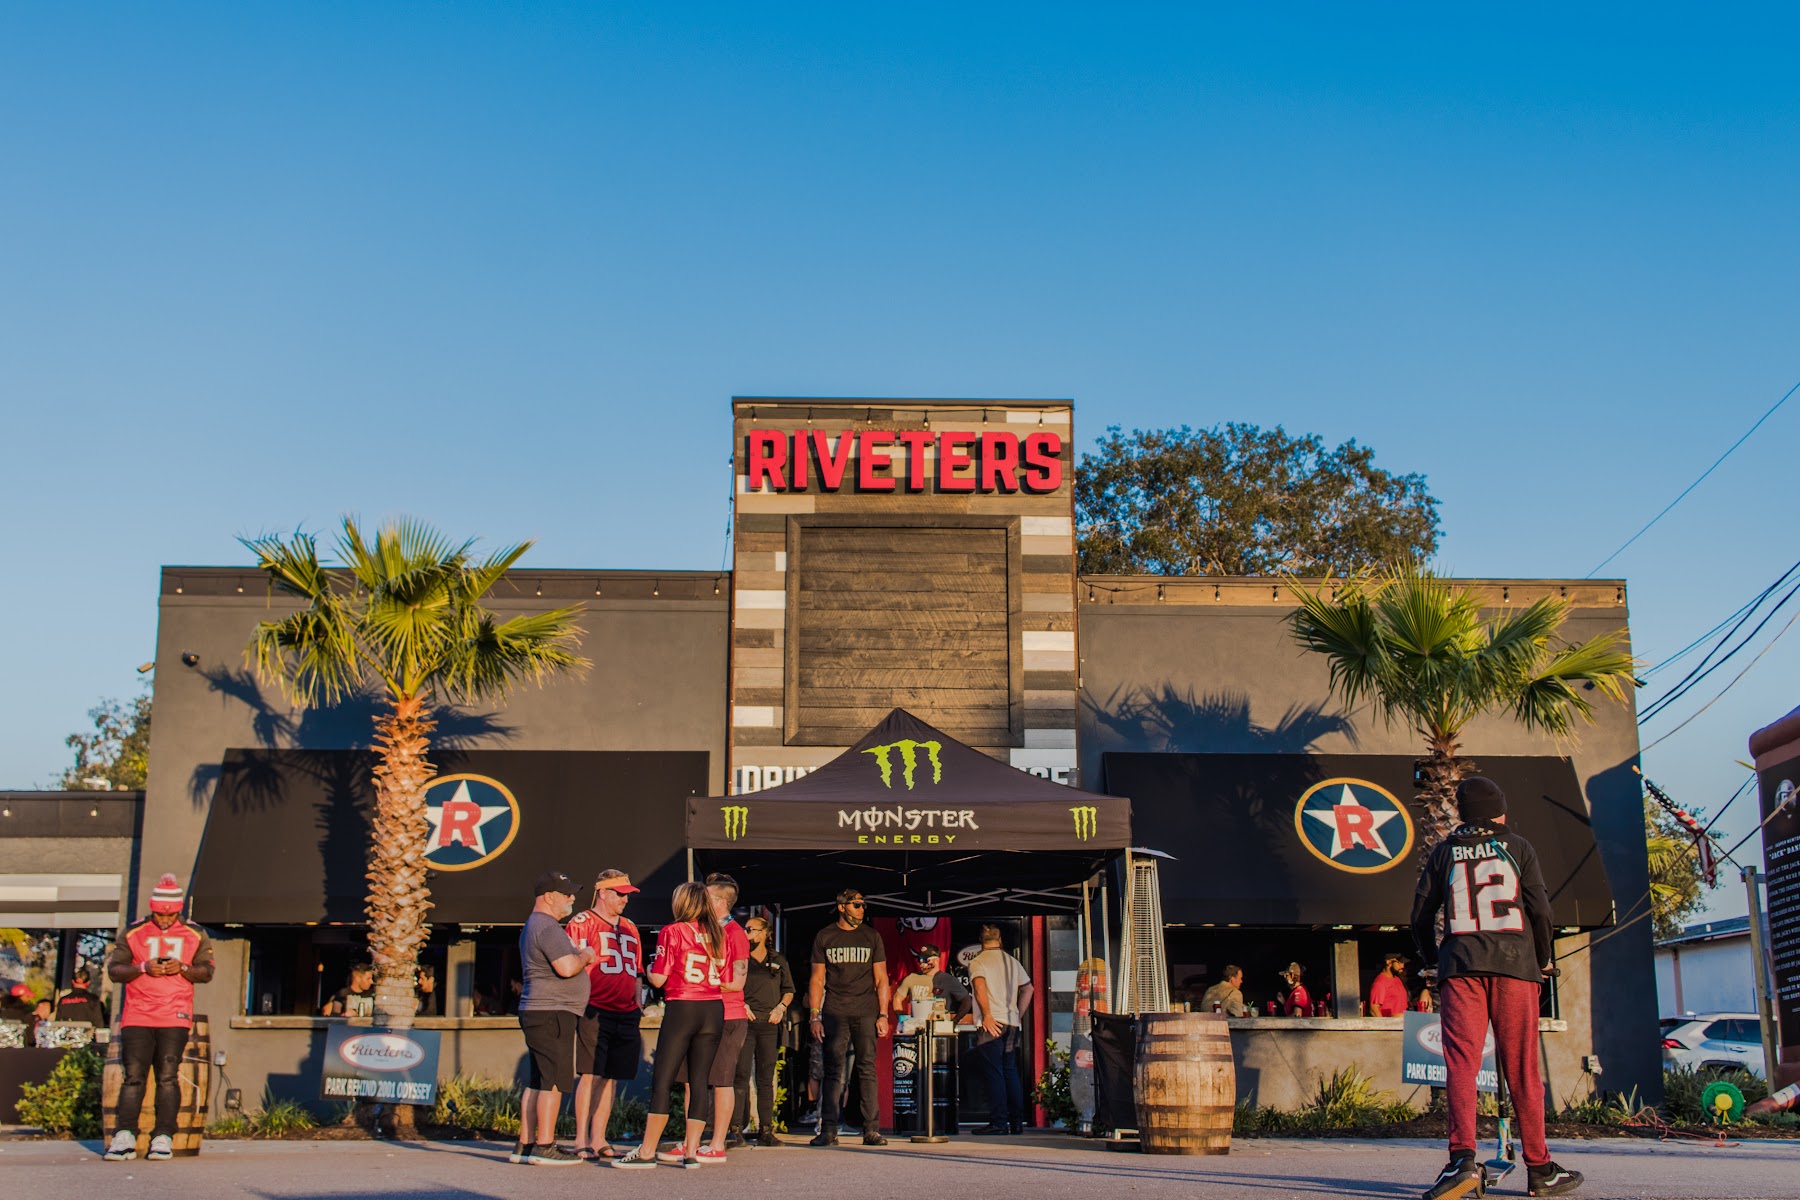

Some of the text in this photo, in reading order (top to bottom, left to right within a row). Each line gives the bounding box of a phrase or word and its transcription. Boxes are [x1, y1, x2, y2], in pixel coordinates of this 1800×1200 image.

[748, 429, 1063, 491] RIVETERS
[438, 801, 482, 847] R
[837, 806, 980, 832] MONSTER
[1332, 804, 1382, 850] R
[857, 834, 957, 844] ENERGY
[1449, 858, 1524, 934] 12
[598, 931, 638, 977] 55
[826, 947, 871, 963] SECURITY
[912, 985, 930, 997] NFC
[1406, 1062, 1427, 1080] PARK
[324, 1077, 432, 1100] PARK BEHIND 2001 ODYSSEY
